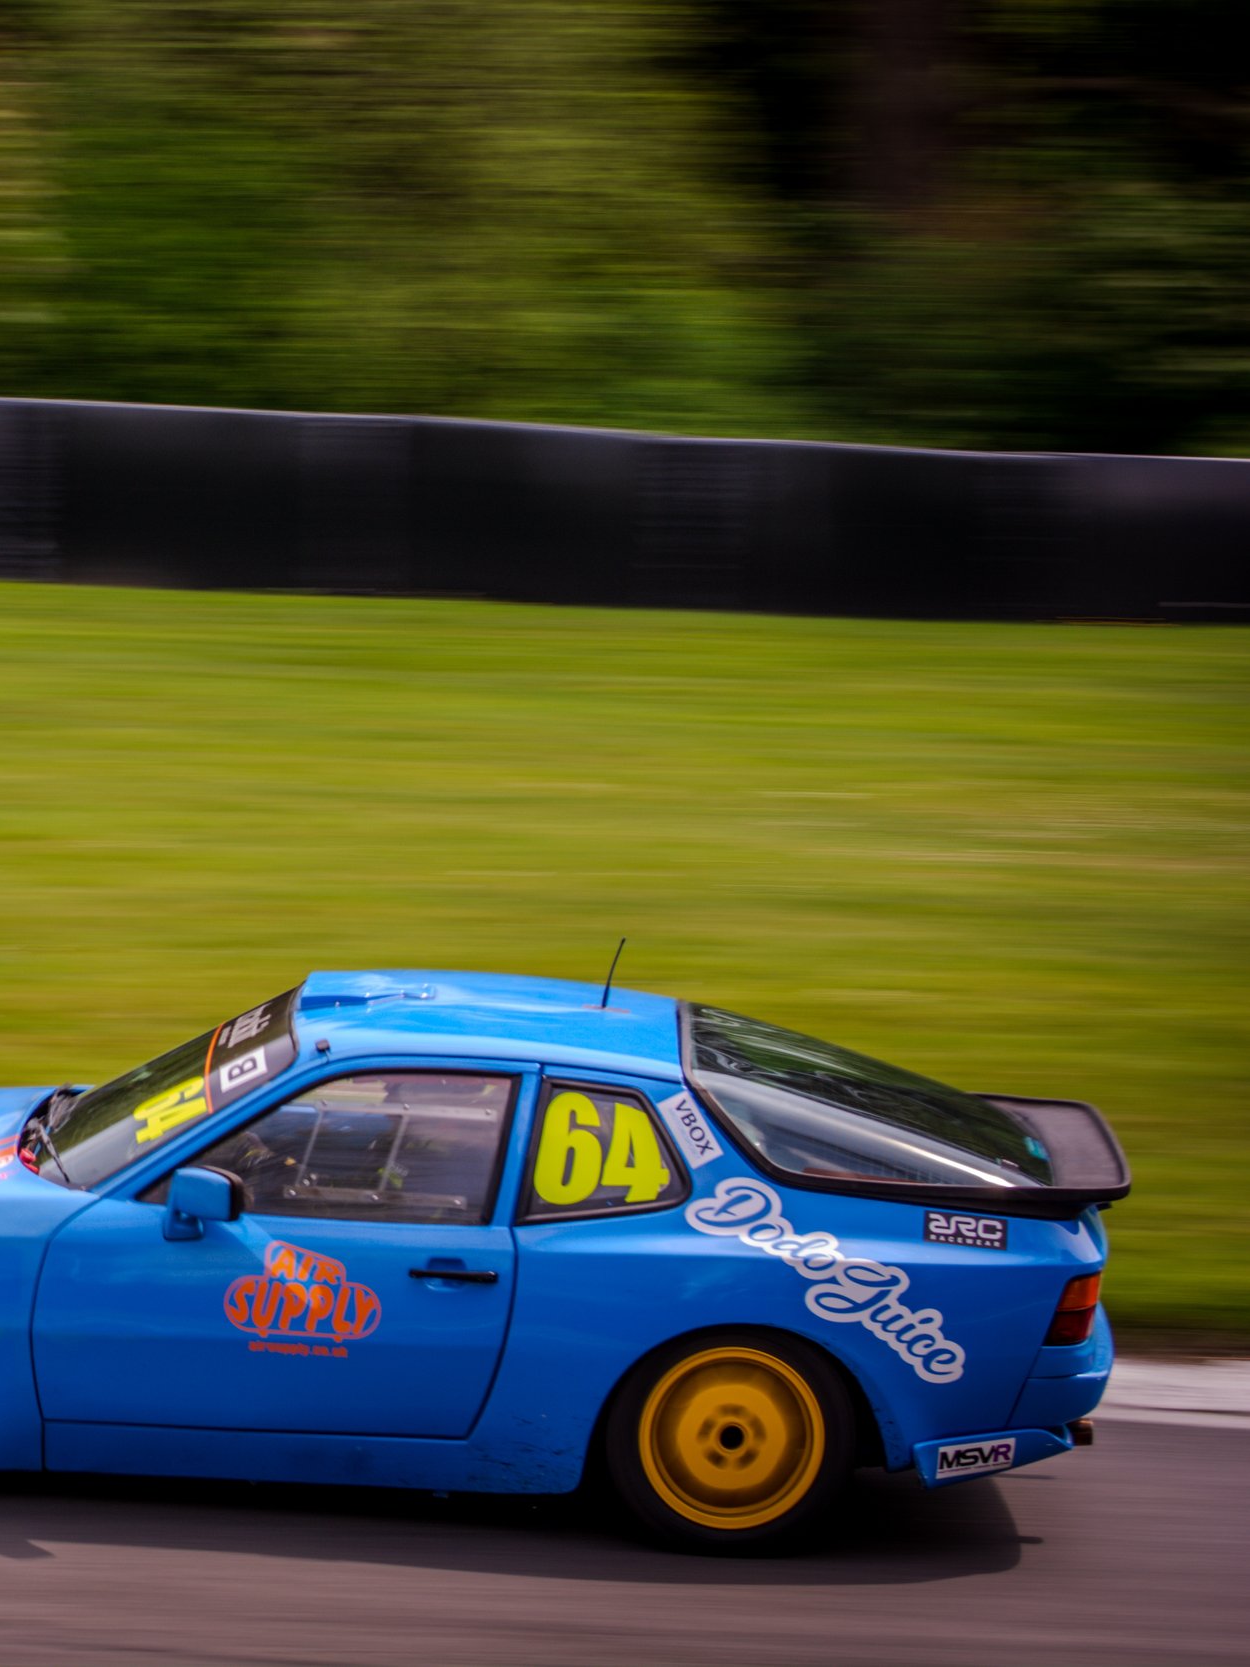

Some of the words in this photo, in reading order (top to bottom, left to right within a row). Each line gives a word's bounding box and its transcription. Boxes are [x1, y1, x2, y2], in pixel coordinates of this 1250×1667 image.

[133, 1075, 207, 1145] 64
[674, 1098, 715, 1157] VBOX
[533, 1091, 670, 1205] 64
[270, 1248, 342, 1285] AIR
[929, 1233, 1002, 1248] RACEWEAR
[228, 1280, 376, 1336] SUPPLY
[689, 1181, 841, 1276] Dodo
[809, 1261, 962, 1380] Juice
[938, 1443, 1012, 1471] MSVR
